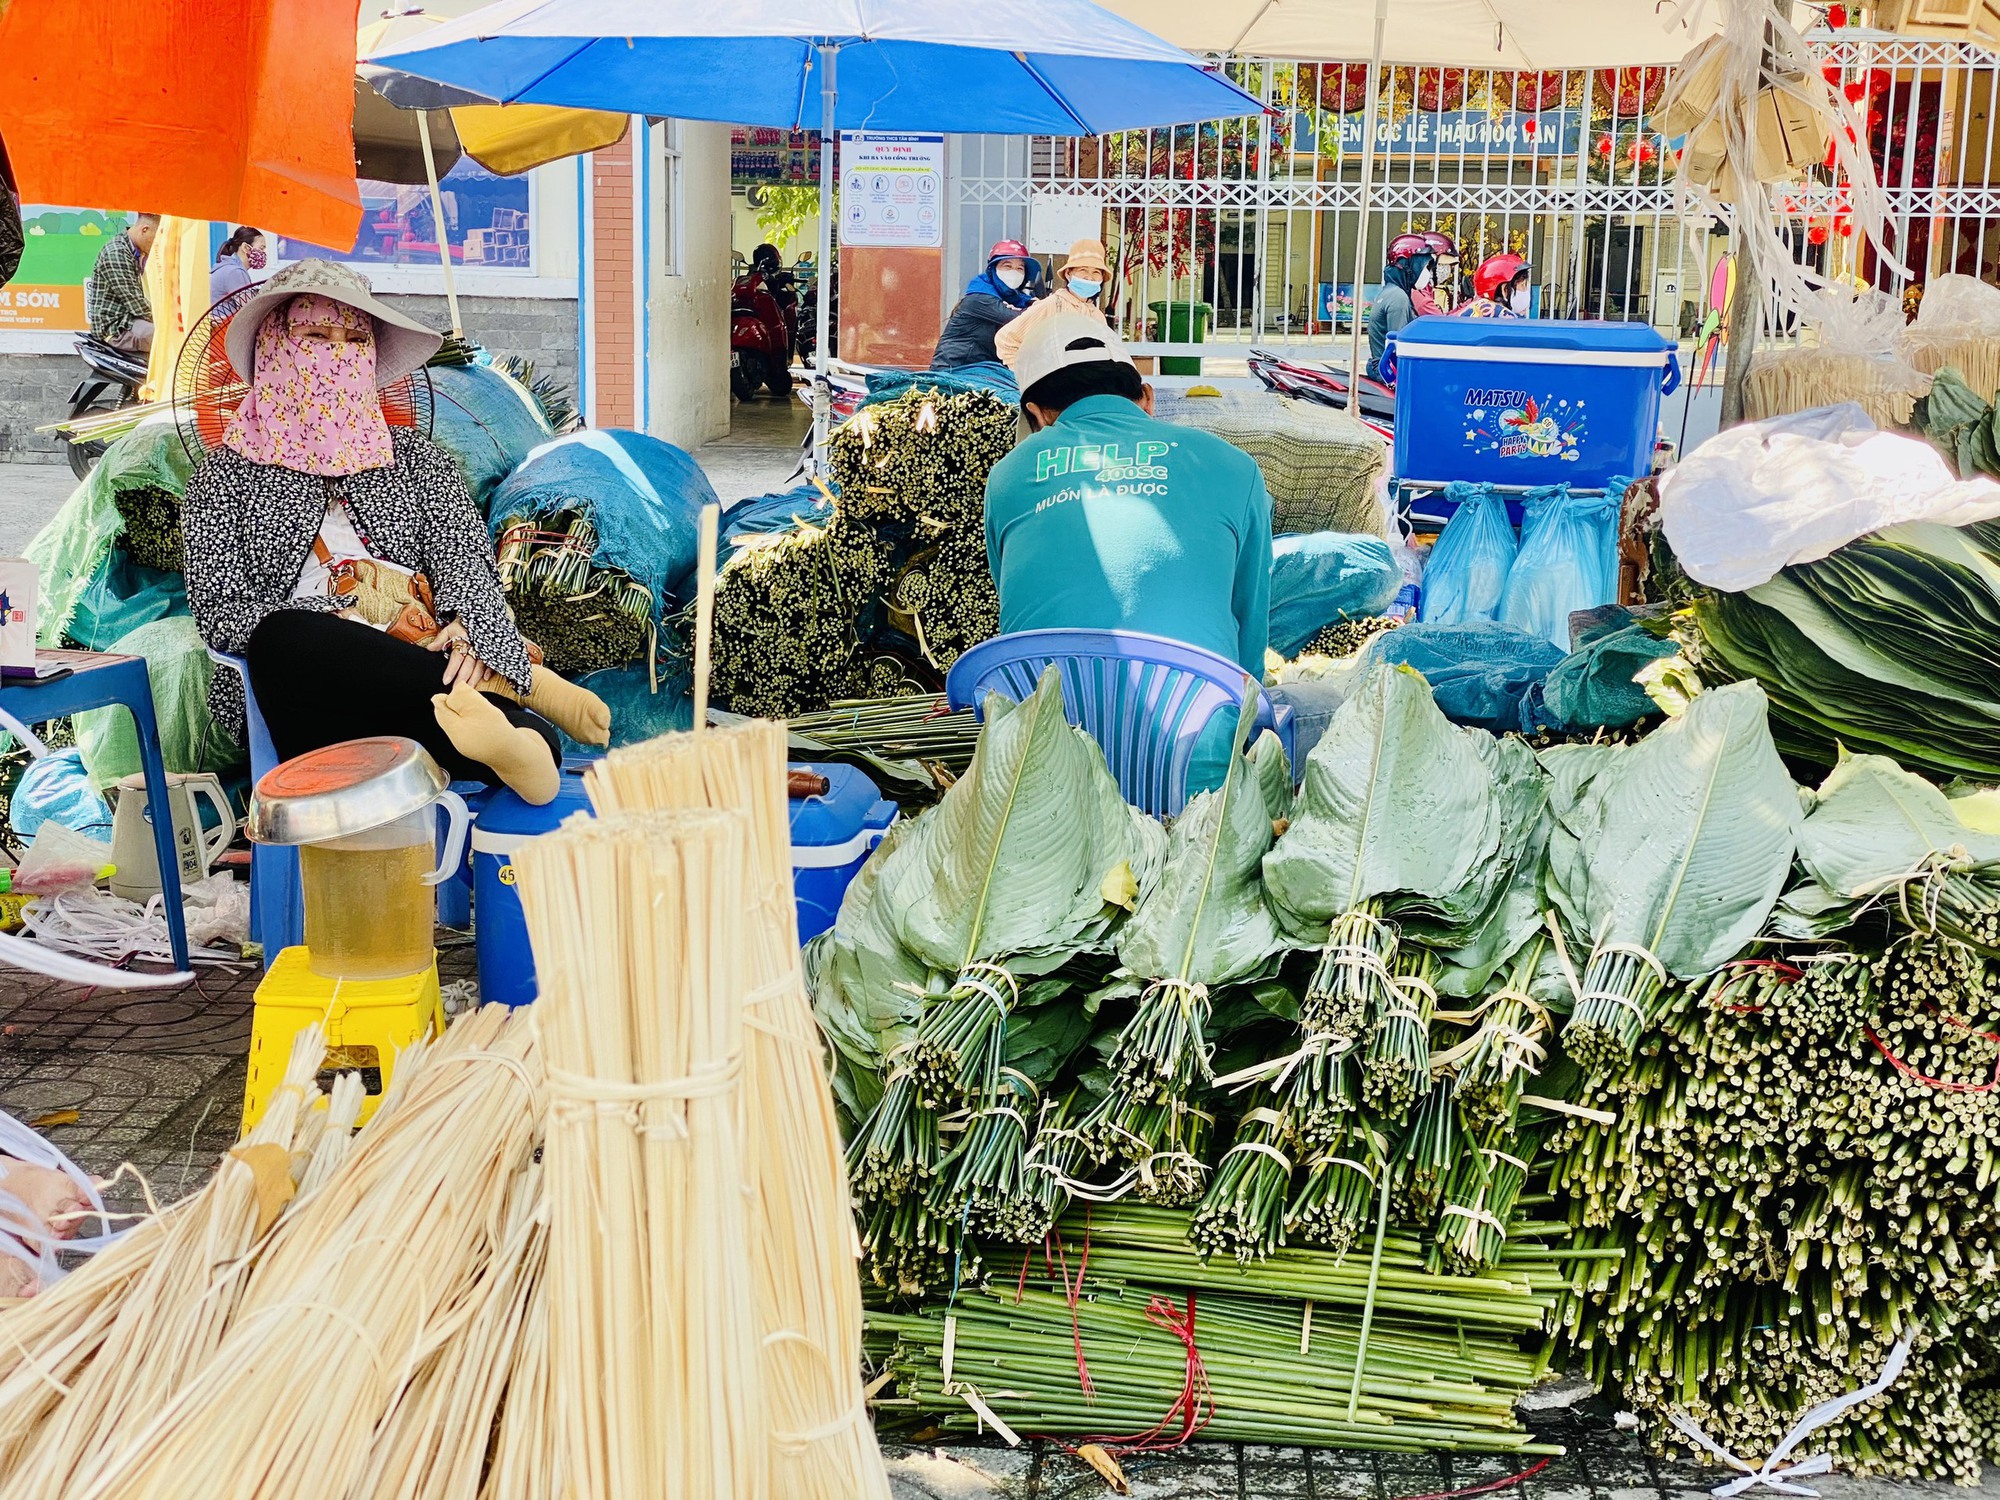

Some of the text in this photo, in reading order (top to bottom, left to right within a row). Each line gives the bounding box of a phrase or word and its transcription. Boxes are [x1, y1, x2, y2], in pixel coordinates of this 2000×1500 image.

[1373, 123, 1402, 147] ỌC
[1406, 114, 1430, 142] LỄ
[1440, 119, 1477, 147] HẬU
[1480, 124, 1517, 148] HỌC
[1464, 388, 1527, 408] MATSU
[1502, 434, 1528, 446] HAPPY
[1499, 444, 1529, 458] PARTY
[1035, 441, 1169, 482] HELP
[1094, 465, 1168, 482] 400SC
[1034, 482, 1169, 514] MUỐN LÀ ĐƯỢC
[500, 869, 515, 881] 45
